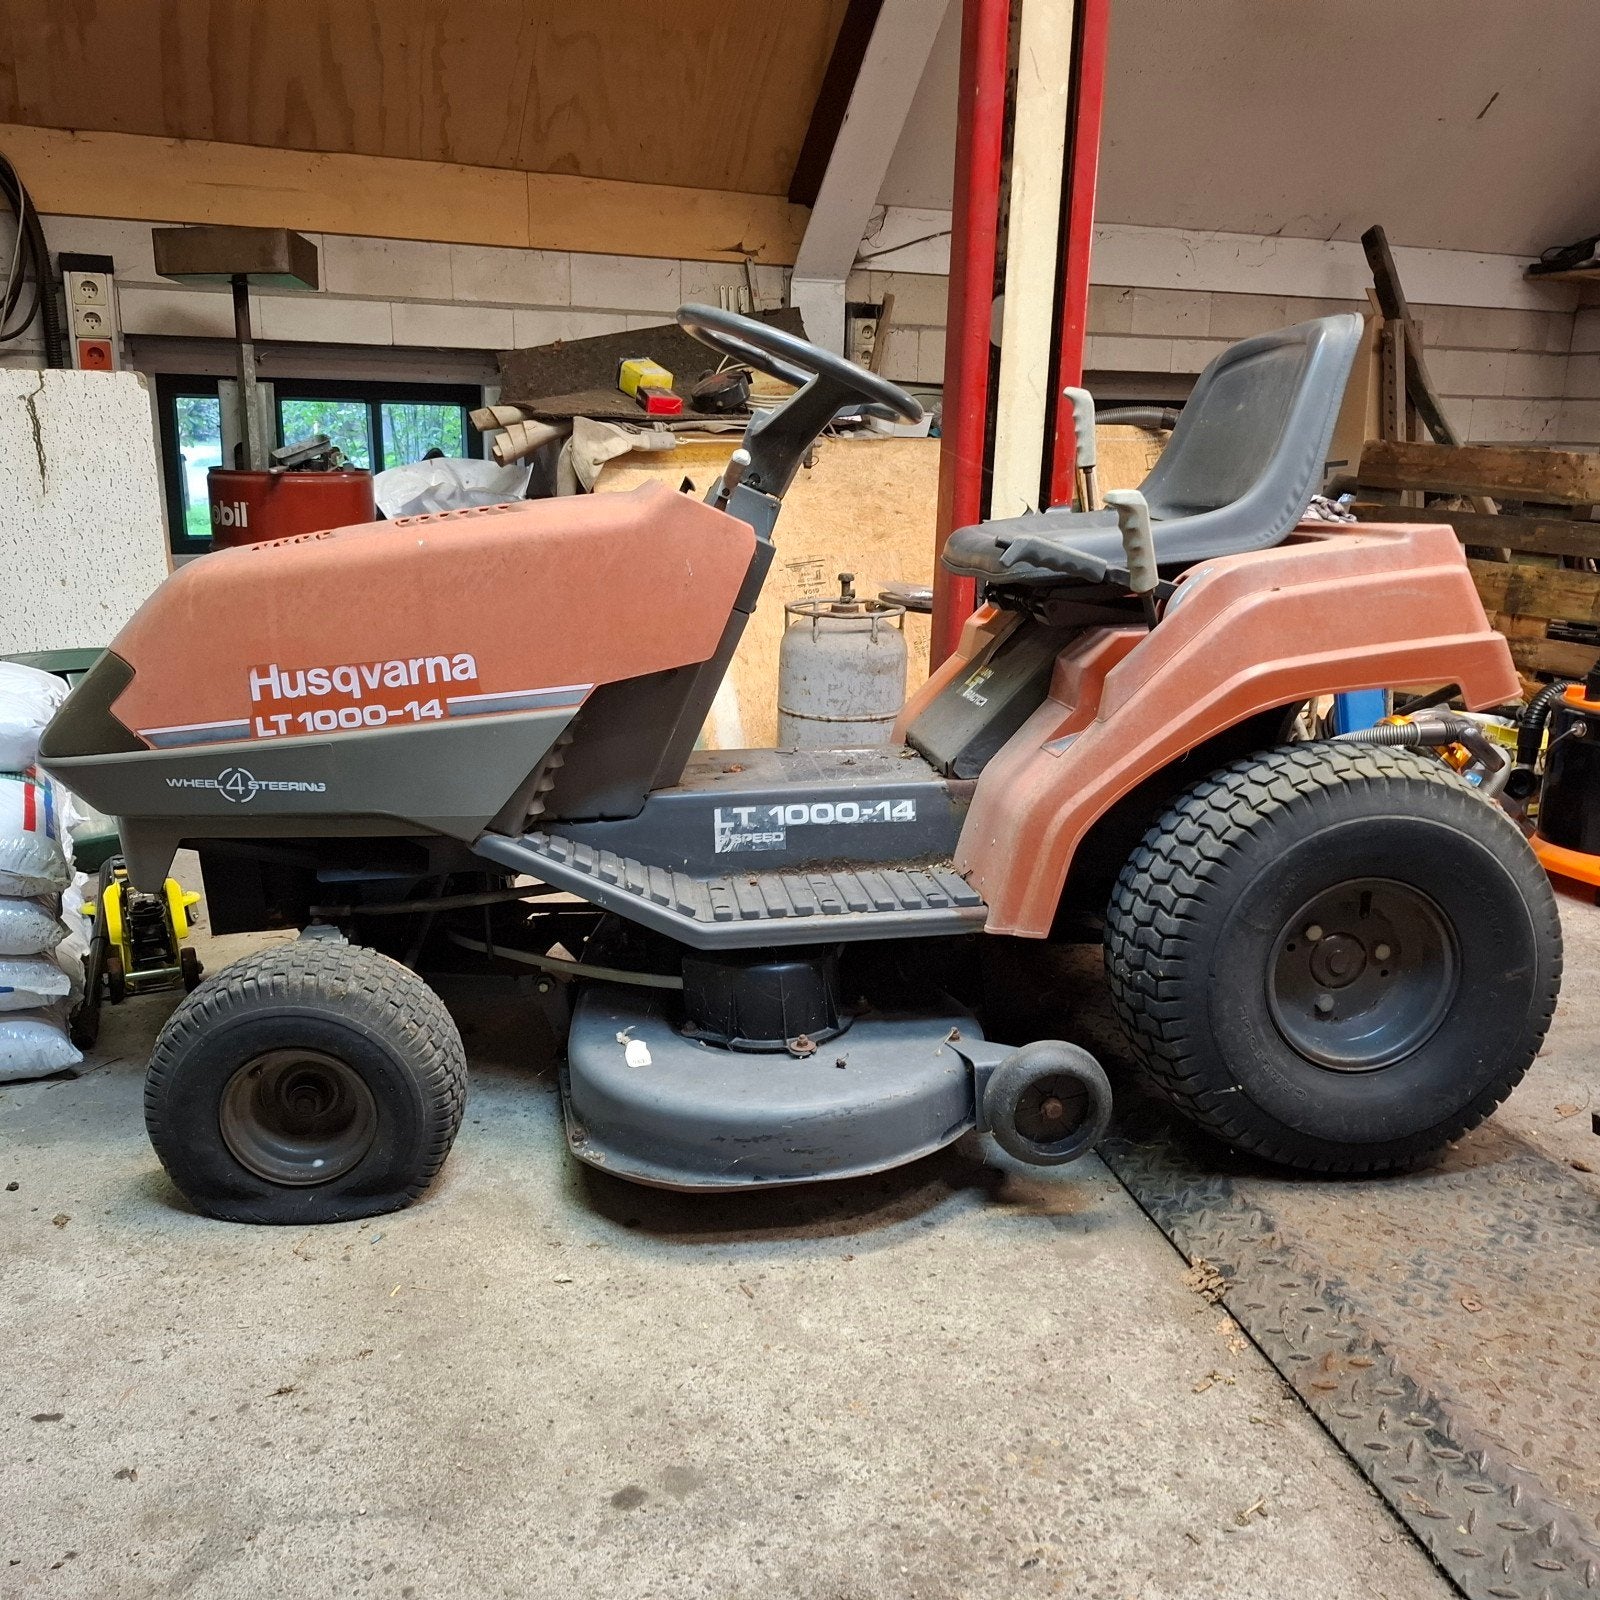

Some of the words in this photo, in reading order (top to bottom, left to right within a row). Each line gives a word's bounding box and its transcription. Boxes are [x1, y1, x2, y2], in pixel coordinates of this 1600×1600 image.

[212, 500, 248, 528] obil
[250, 653, 477, 701] Husqvarna
[255, 713, 293, 737] LT
[297, 699, 444, 733] 1000-14
[166, 778, 223, 789] WHEEL
[226, 772, 245, 795] 4
[248, 780, 326, 792] STEERING
[714, 806, 757, 829] LT
[768, 800, 916, 826] 1000-14
